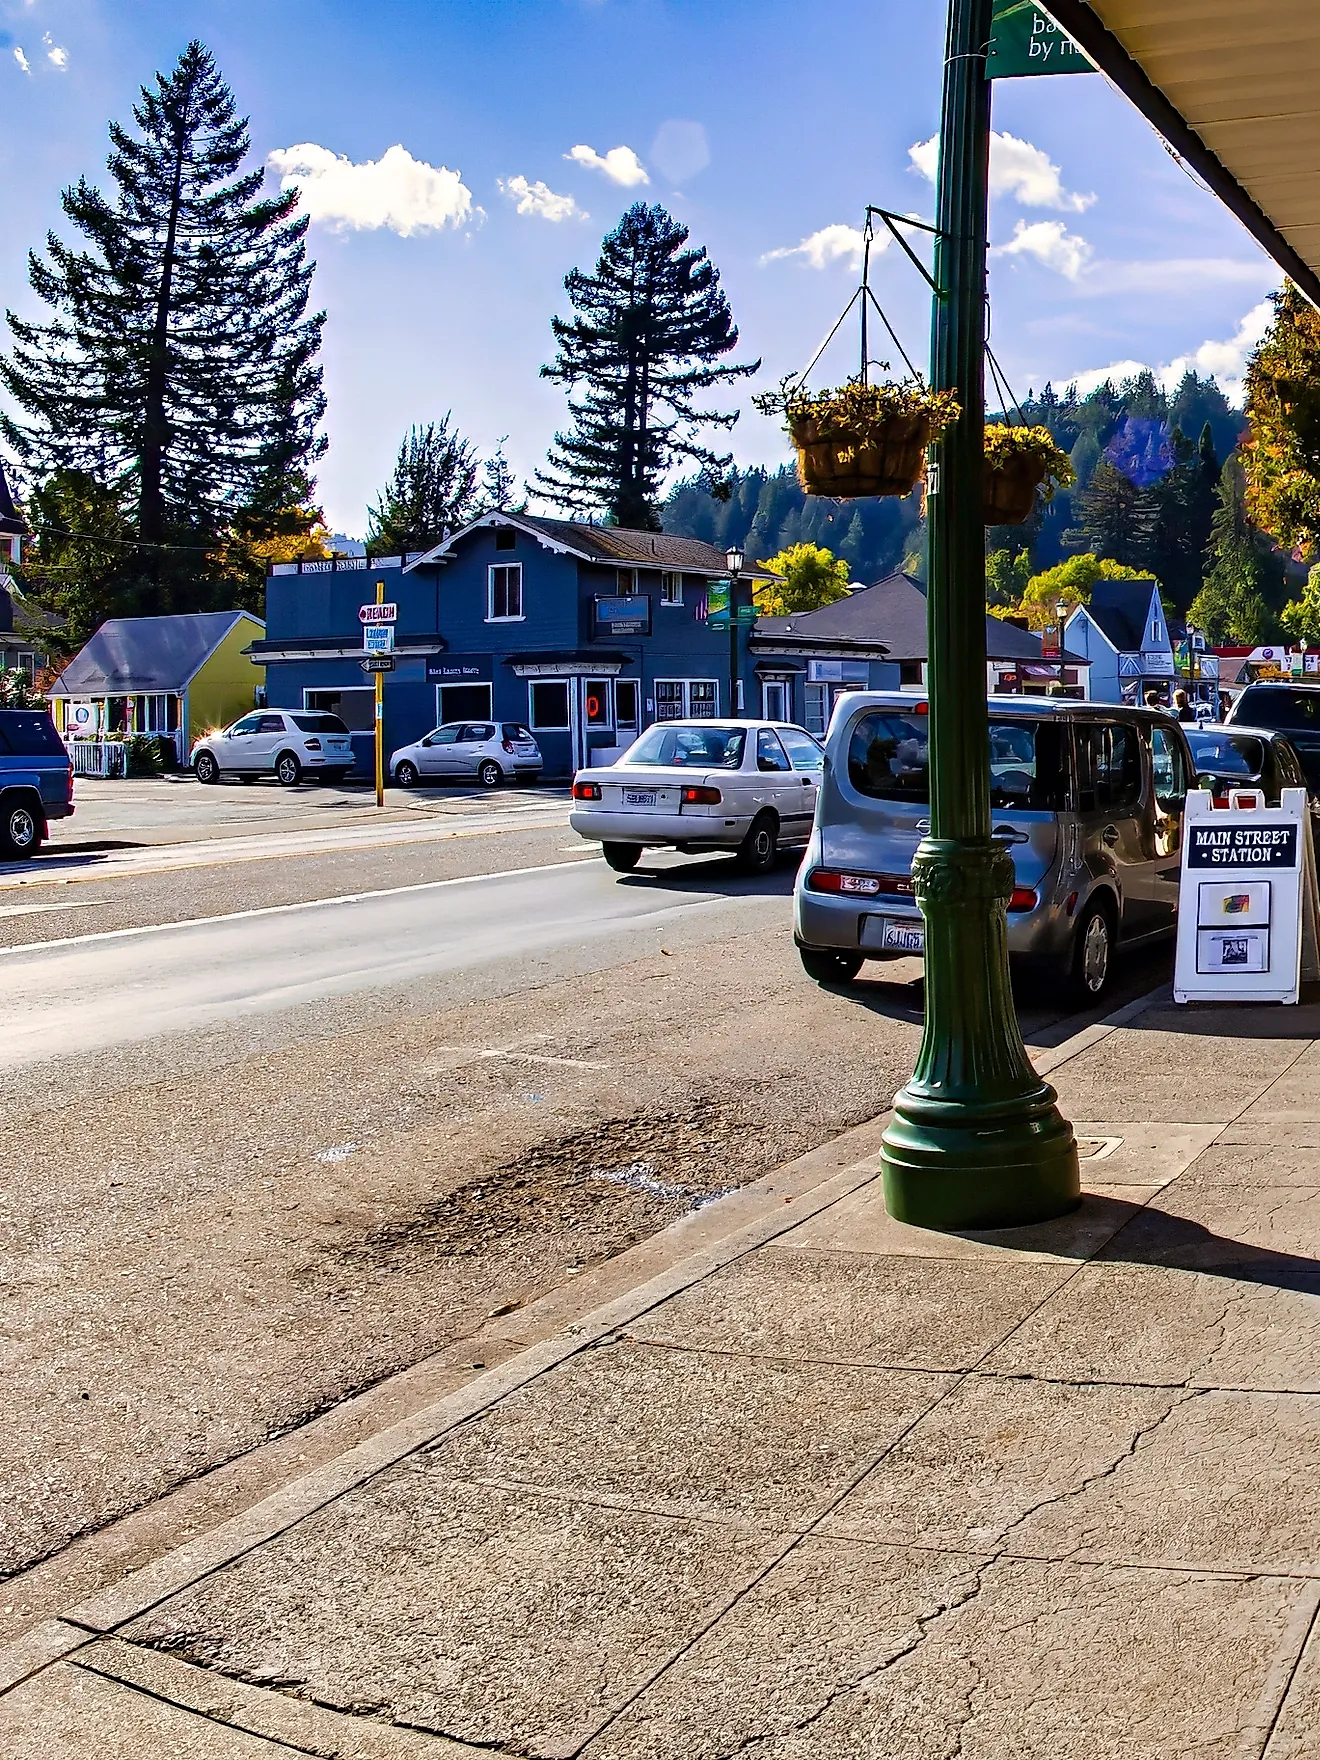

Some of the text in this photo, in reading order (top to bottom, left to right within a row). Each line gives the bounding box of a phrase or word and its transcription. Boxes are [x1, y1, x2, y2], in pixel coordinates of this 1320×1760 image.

[1033, 12, 1057, 34] ba
[1028, 36, 1054, 62] by
[1195, 830, 1290, 846] MAIN STREET
[1211, 847, 1272, 862] STATION
